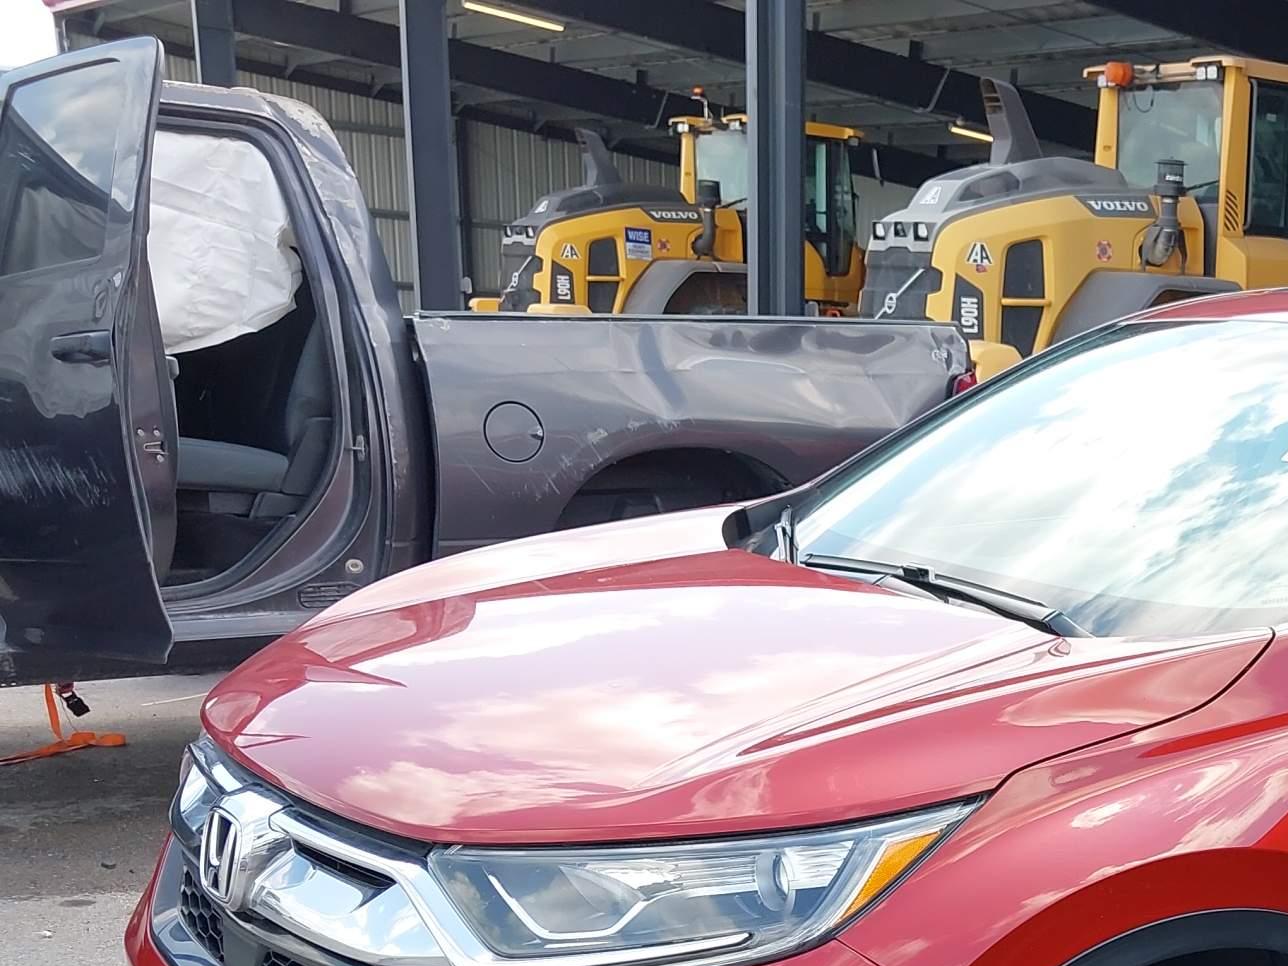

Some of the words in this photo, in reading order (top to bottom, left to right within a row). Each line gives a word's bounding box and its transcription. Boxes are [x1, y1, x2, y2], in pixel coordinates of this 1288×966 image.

[1087, 200, 1149, 212] VOLVO
[649, 210, 698, 220] VOLVO
[627, 229, 650, 242] WISE
[557, 275, 571, 300] L90H
[960, 296, 979, 334] L90H
